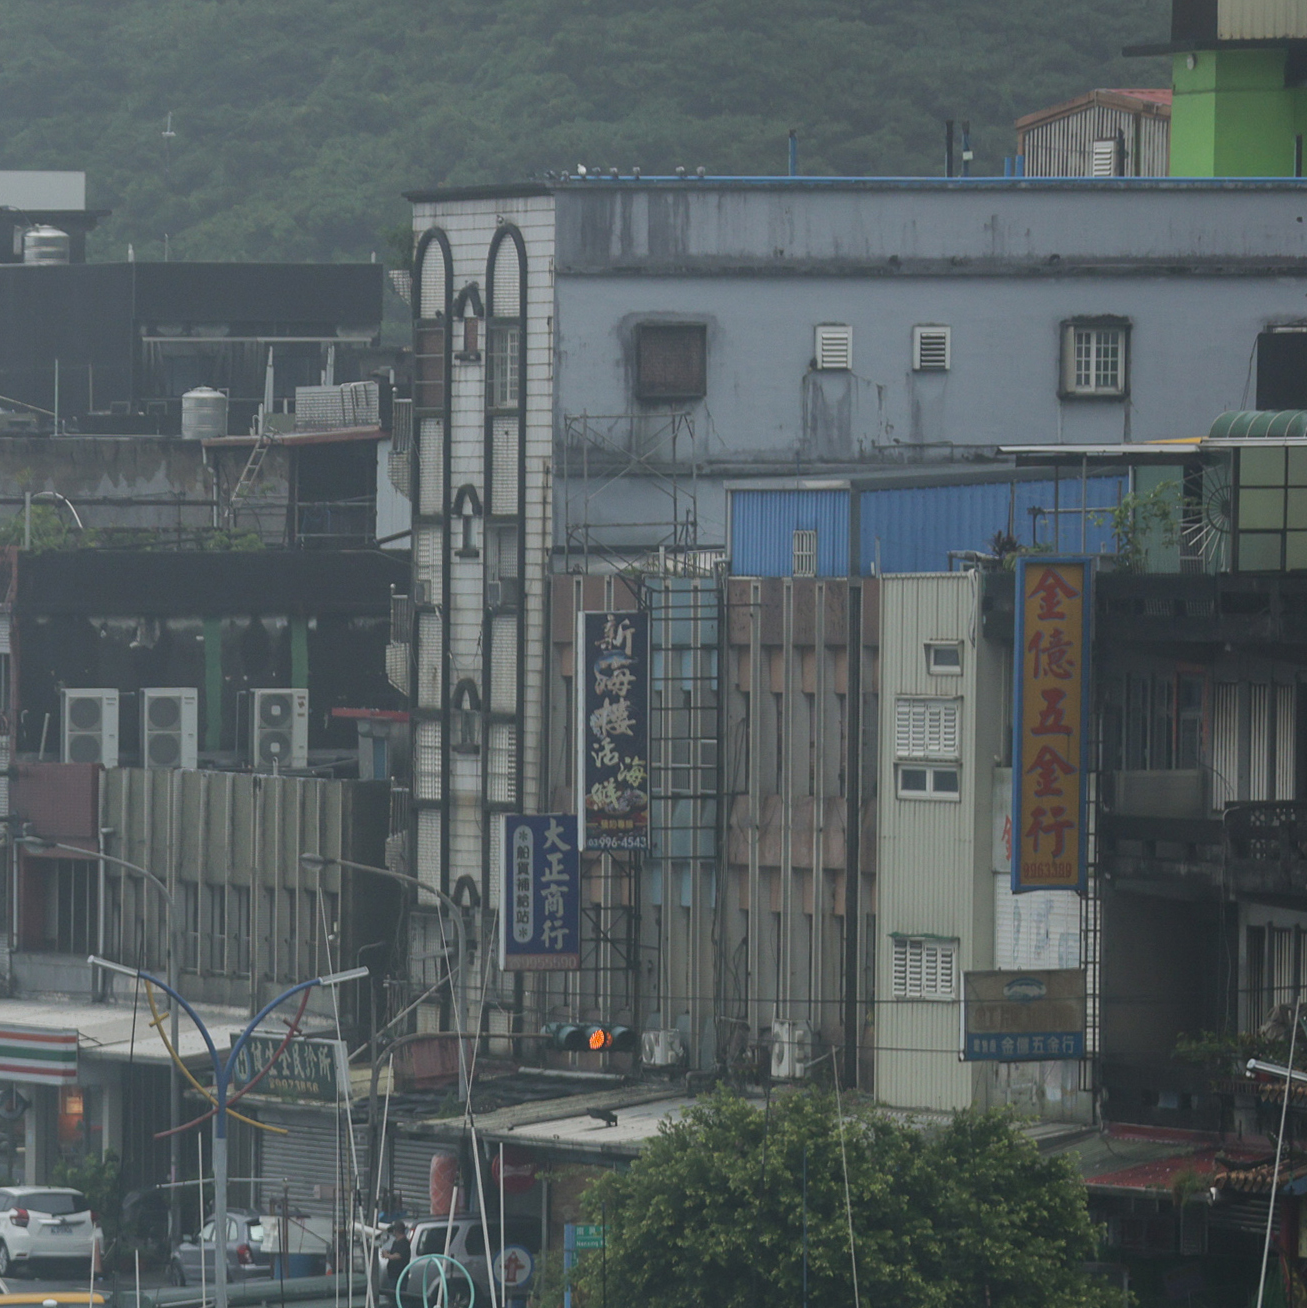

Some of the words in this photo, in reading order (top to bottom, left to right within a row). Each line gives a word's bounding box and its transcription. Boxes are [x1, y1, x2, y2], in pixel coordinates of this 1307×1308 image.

[1025, 567, 1081, 860] 金億五金行
[540, 817, 572, 951] 大正商行
